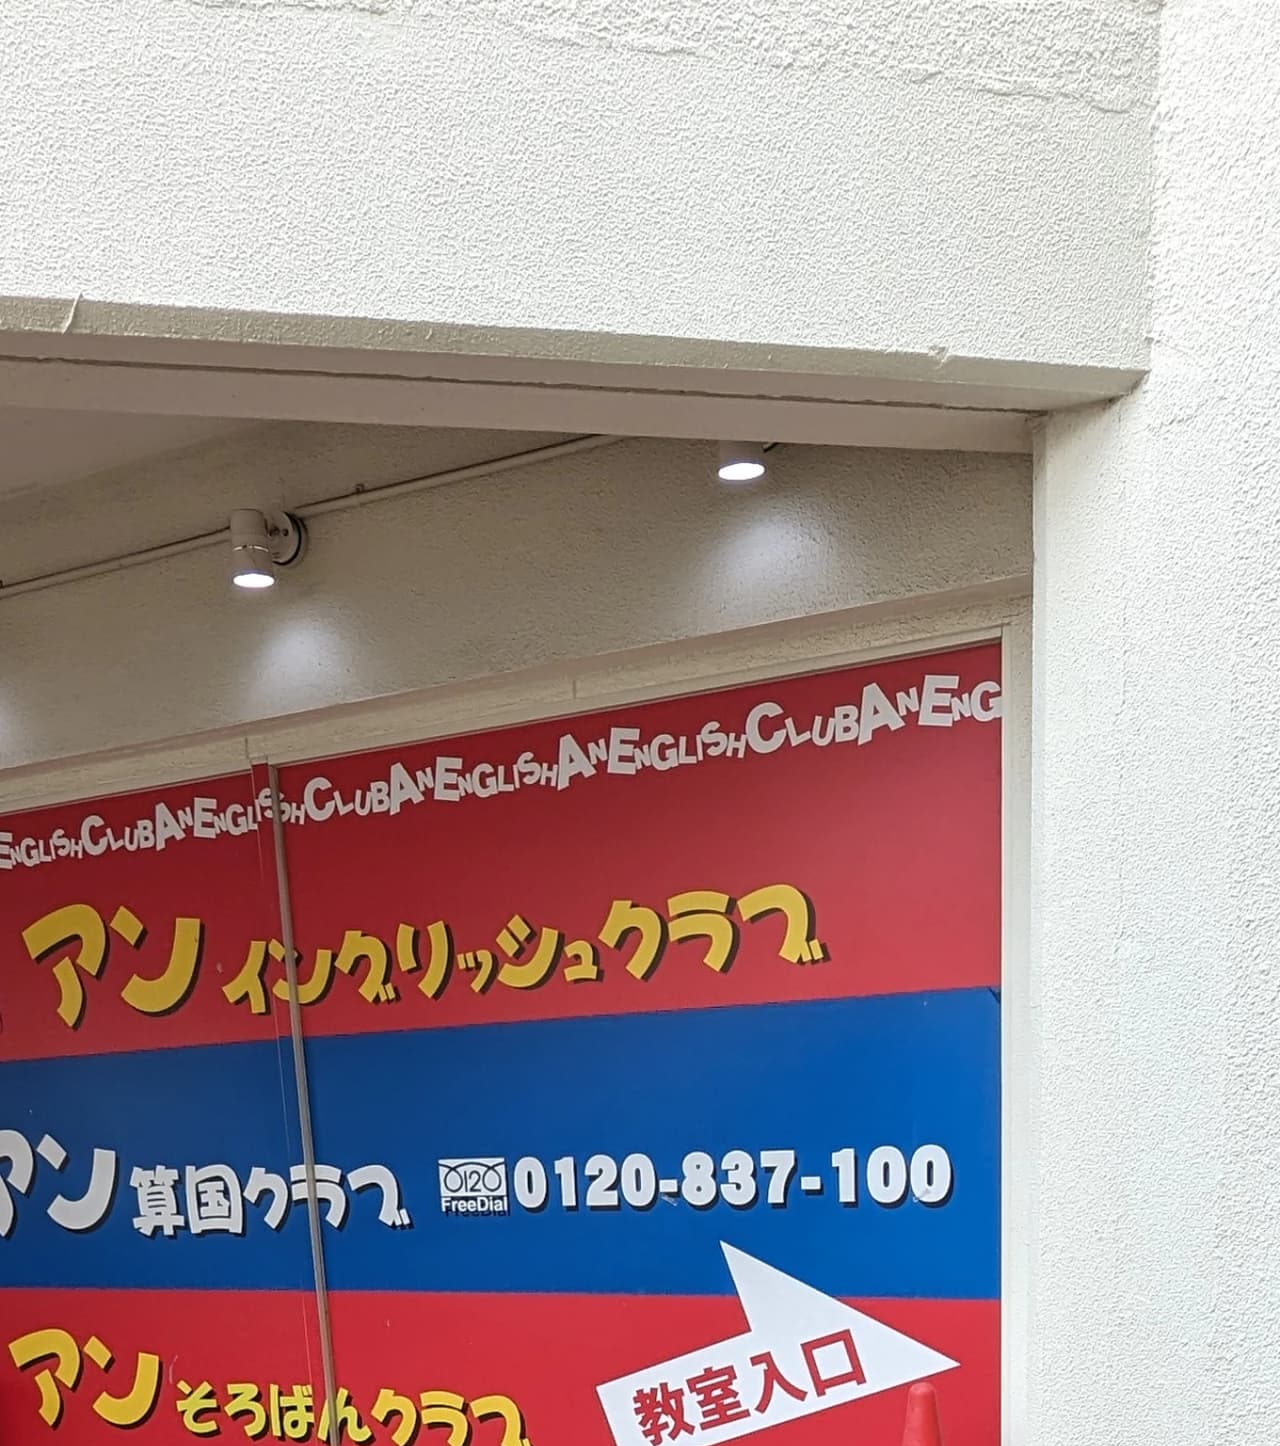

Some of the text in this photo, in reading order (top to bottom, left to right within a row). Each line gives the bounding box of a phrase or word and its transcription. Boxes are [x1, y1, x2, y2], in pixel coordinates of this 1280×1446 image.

[22, 884, 825, 1028] アン イングリッシュクラブ
[130, 1163, 410, 1236] 算国クラブ
[440, 1196, 508, 1213] FreeDial
[513, 1144, 952, 1210] 0120-837-100
[8, 1328, 159, 1427] アン
